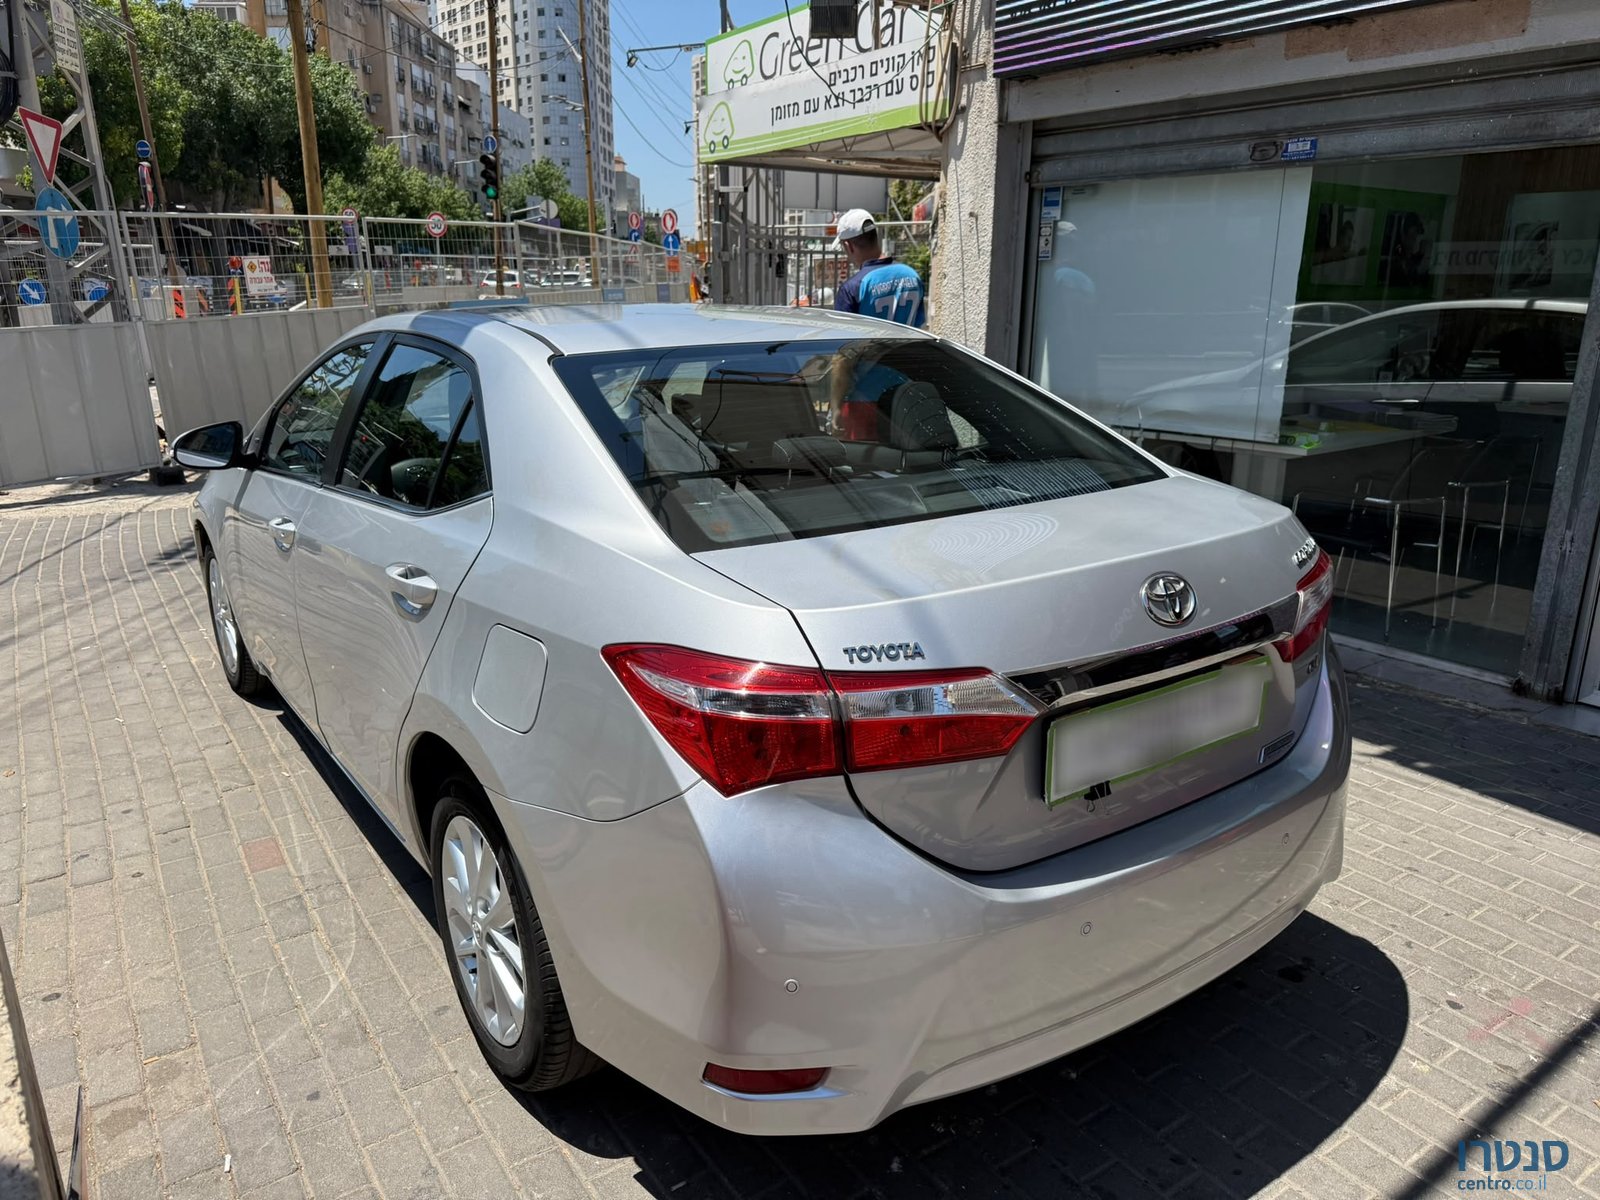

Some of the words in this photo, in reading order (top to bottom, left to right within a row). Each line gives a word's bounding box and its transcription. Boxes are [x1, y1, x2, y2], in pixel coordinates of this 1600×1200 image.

[760, 32, 844, 80] Green
[855, 1, 909, 53] Car
[829, 64, 865, 87] רכבים
[870, 53, 906, 77] קונים
[885, 77, 904, 97] עם
[910, 71, 935, 91] כס
[804, 97, 820, 115] עם
[824, 91, 844, 110] וצא
[849, 83, 880, 109] רכבך
[771, 102, 799, 126] מזומן
[843, 642, 926, 664] TOYOTA
